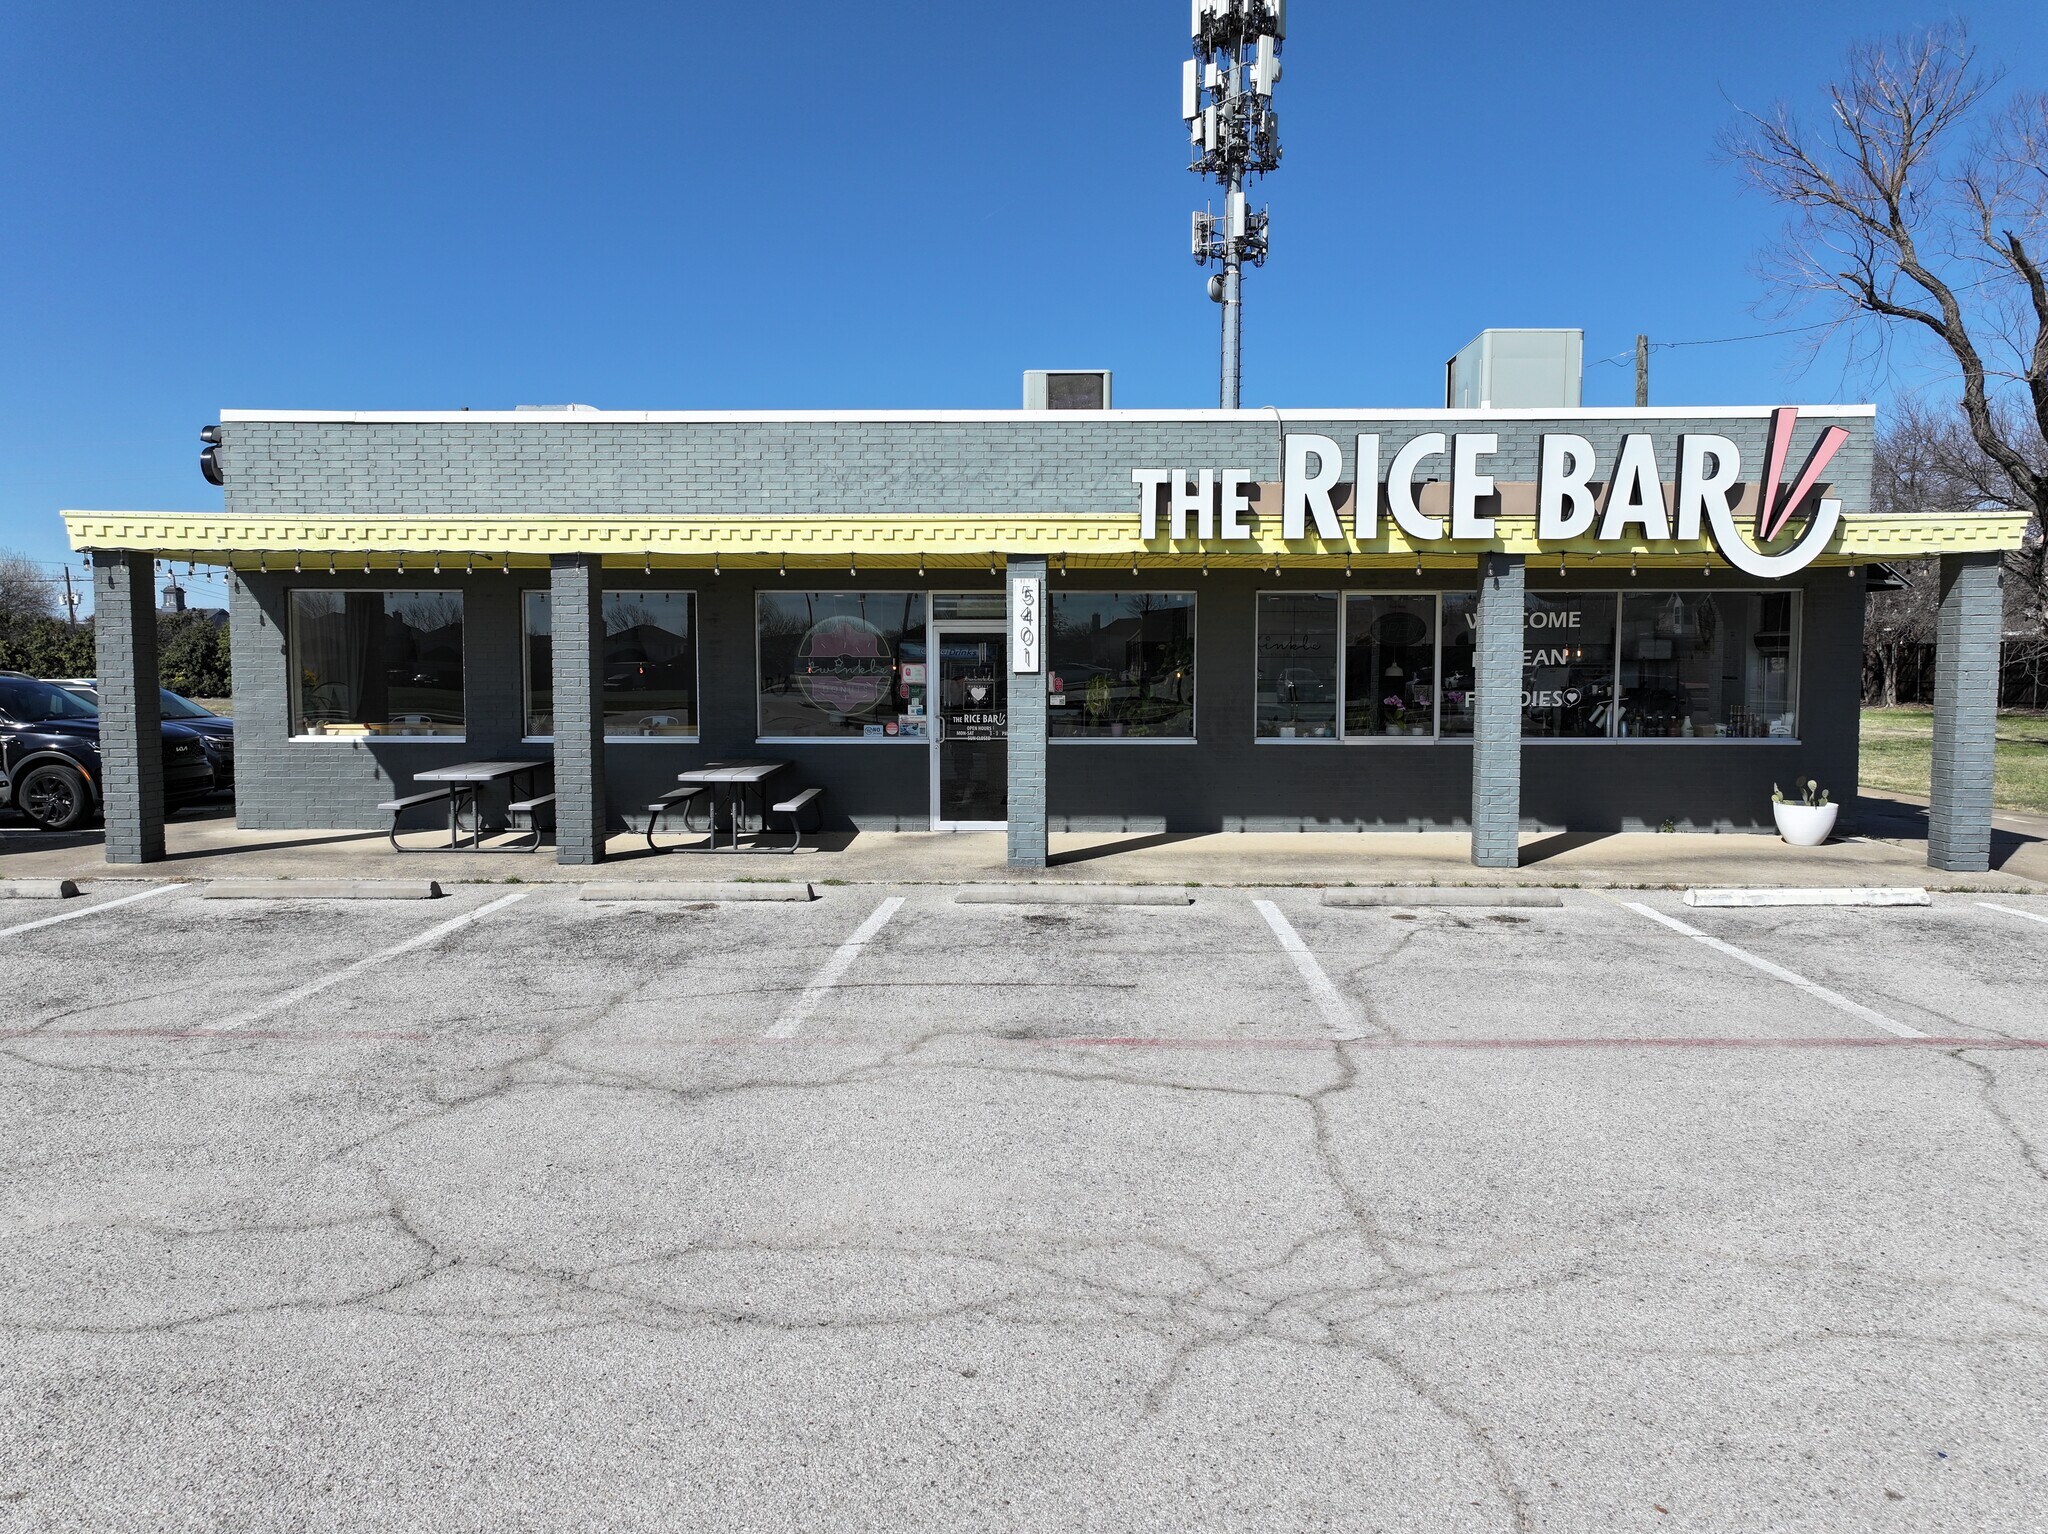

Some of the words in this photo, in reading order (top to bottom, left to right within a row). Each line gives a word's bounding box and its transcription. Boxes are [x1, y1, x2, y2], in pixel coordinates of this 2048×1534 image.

[1131, 468, 1251, 540] THE
[1282, 432, 1499, 541] RICE
[1538, 433, 1843, 578] BAR
[1020, 586, 1035, 667] 5401
[1465, 611, 1582, 629] WOME
[948, 647, 978, 656] Drinks
[1472, 649, 1568, 668] EAN
[806, 658, 889, 674] twinkle
[1465, 690, 1563, 708] FDIES
[963, 714, 981, 723] RICE
